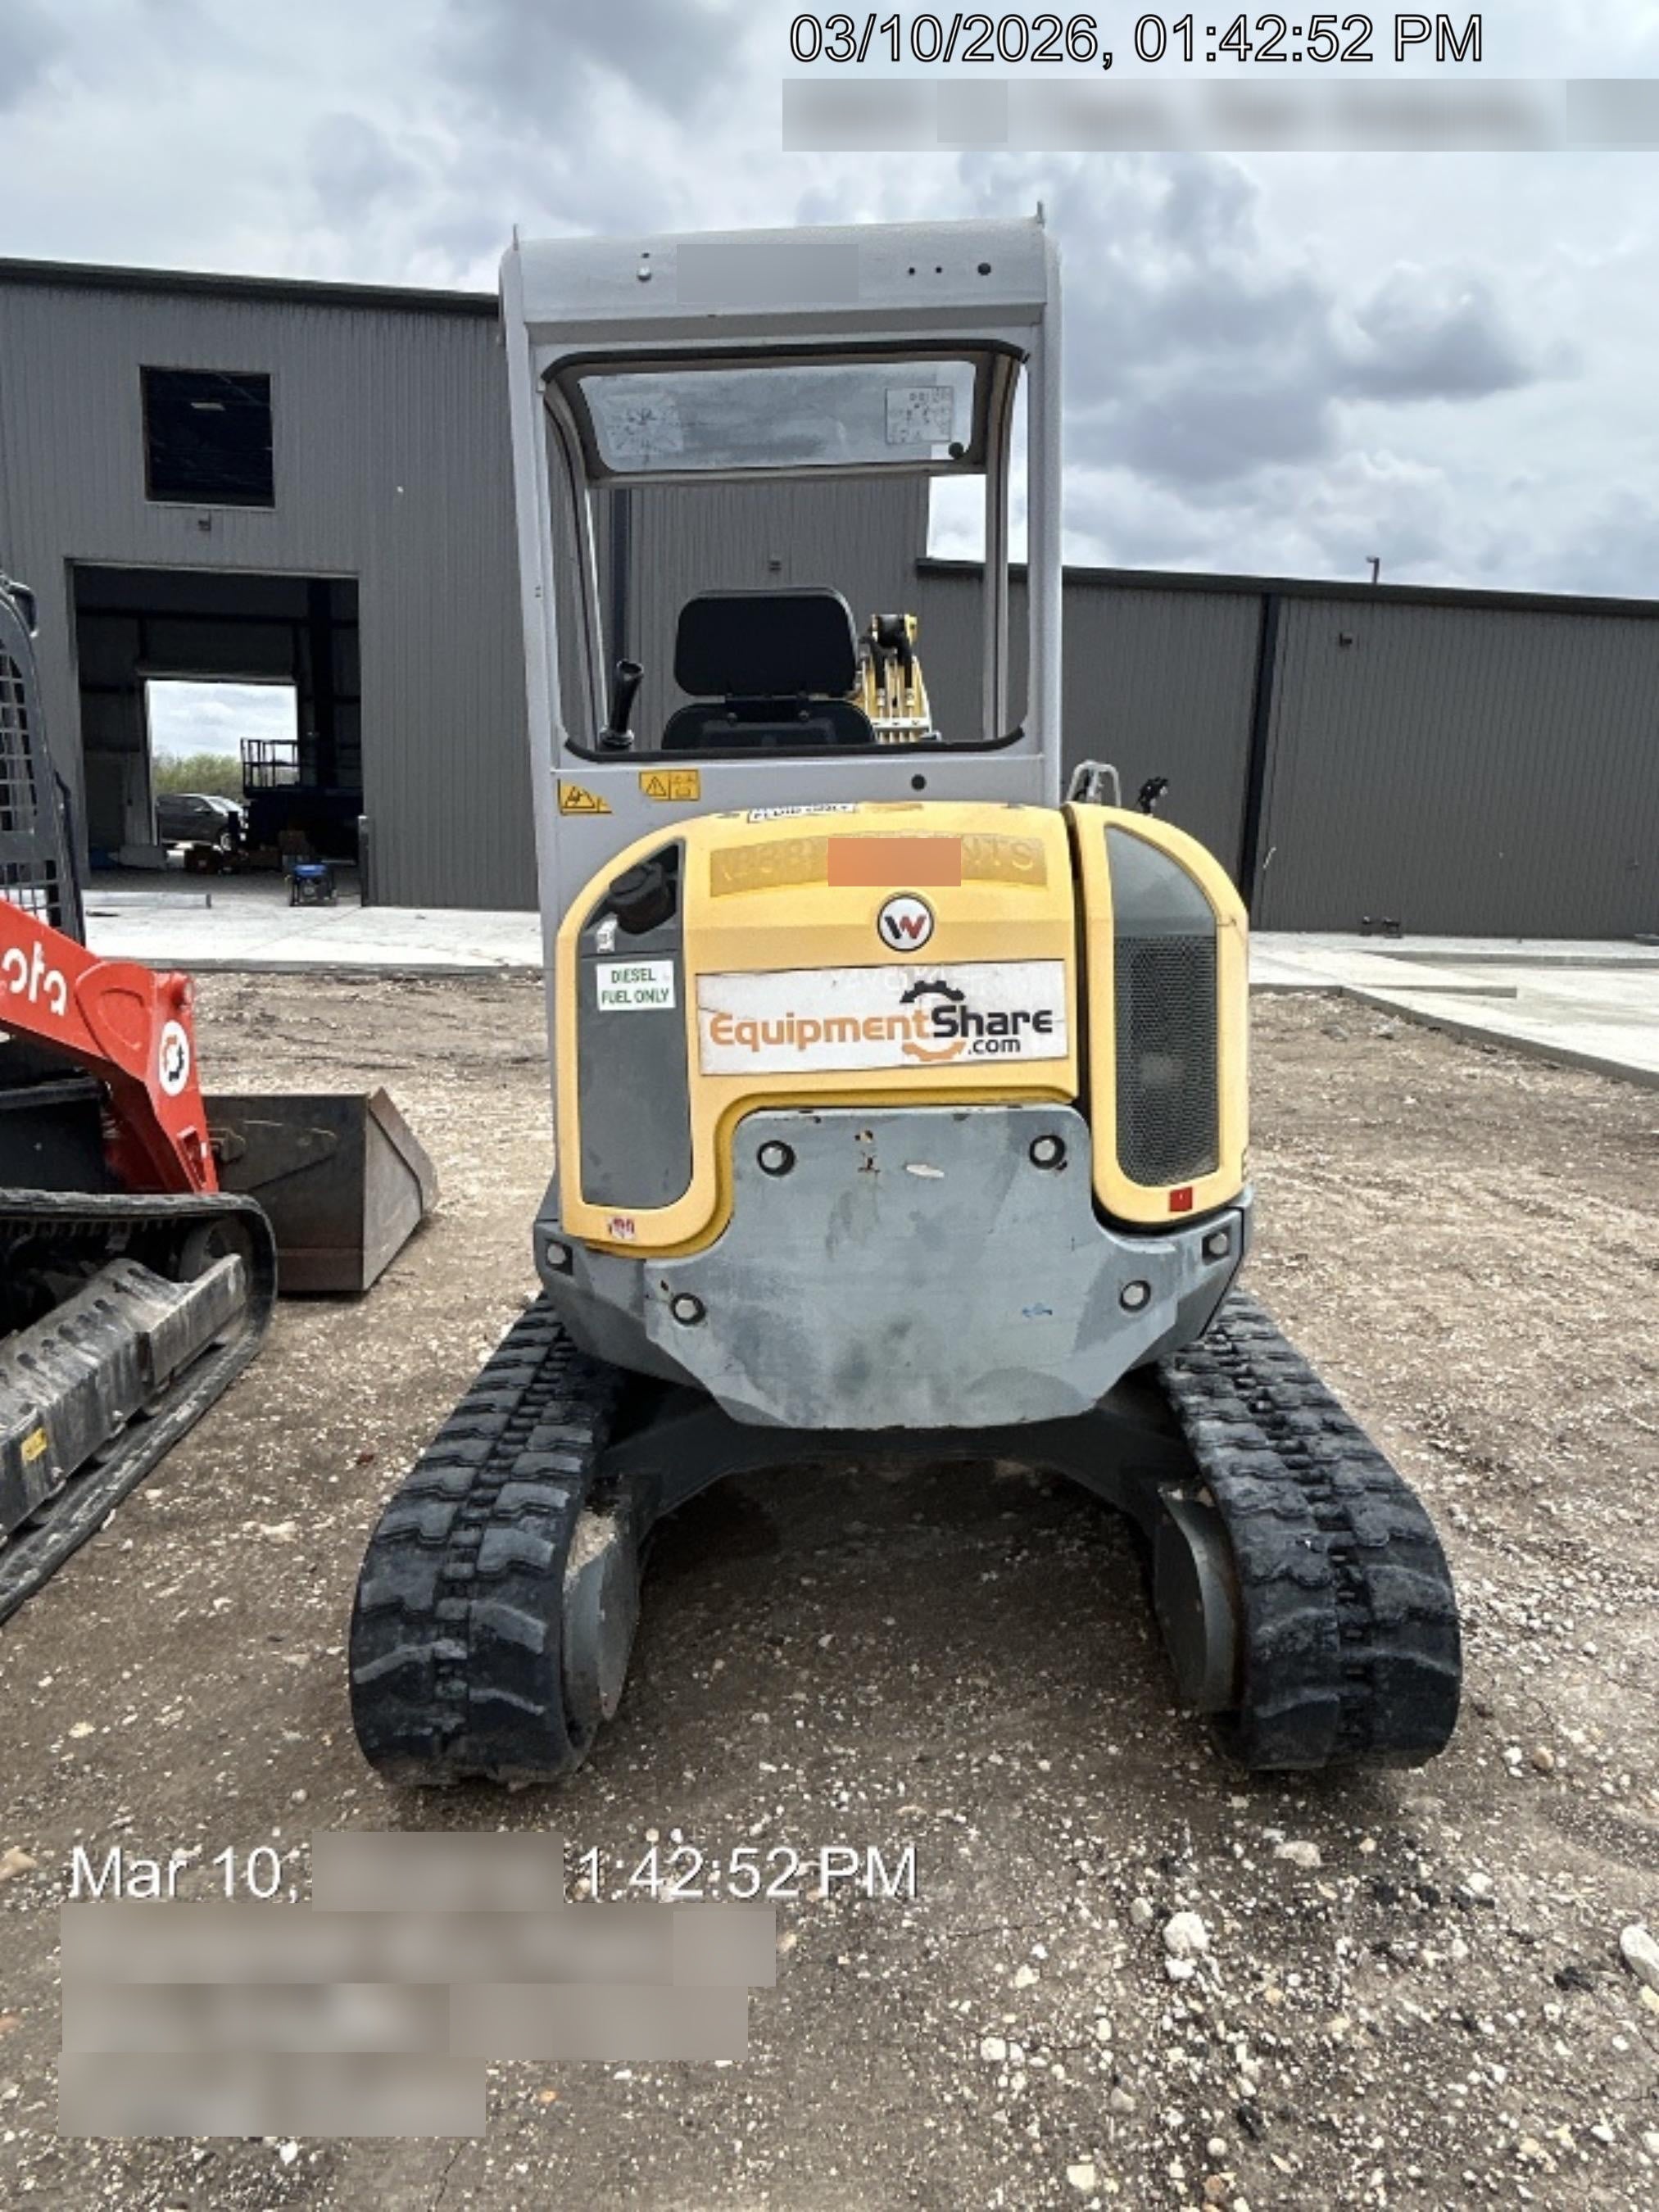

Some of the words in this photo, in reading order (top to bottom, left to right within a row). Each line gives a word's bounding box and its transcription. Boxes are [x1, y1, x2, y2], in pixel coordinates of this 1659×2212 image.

[611, 968, 656, 984] DIESEL
[601, 990, 632, 1005] FUEL
[634, 988, 669, 1004] ONLY
[709, 1004, 1053, 1052] EquipmentShare
[968, 1038, 1021, 1055] .com
